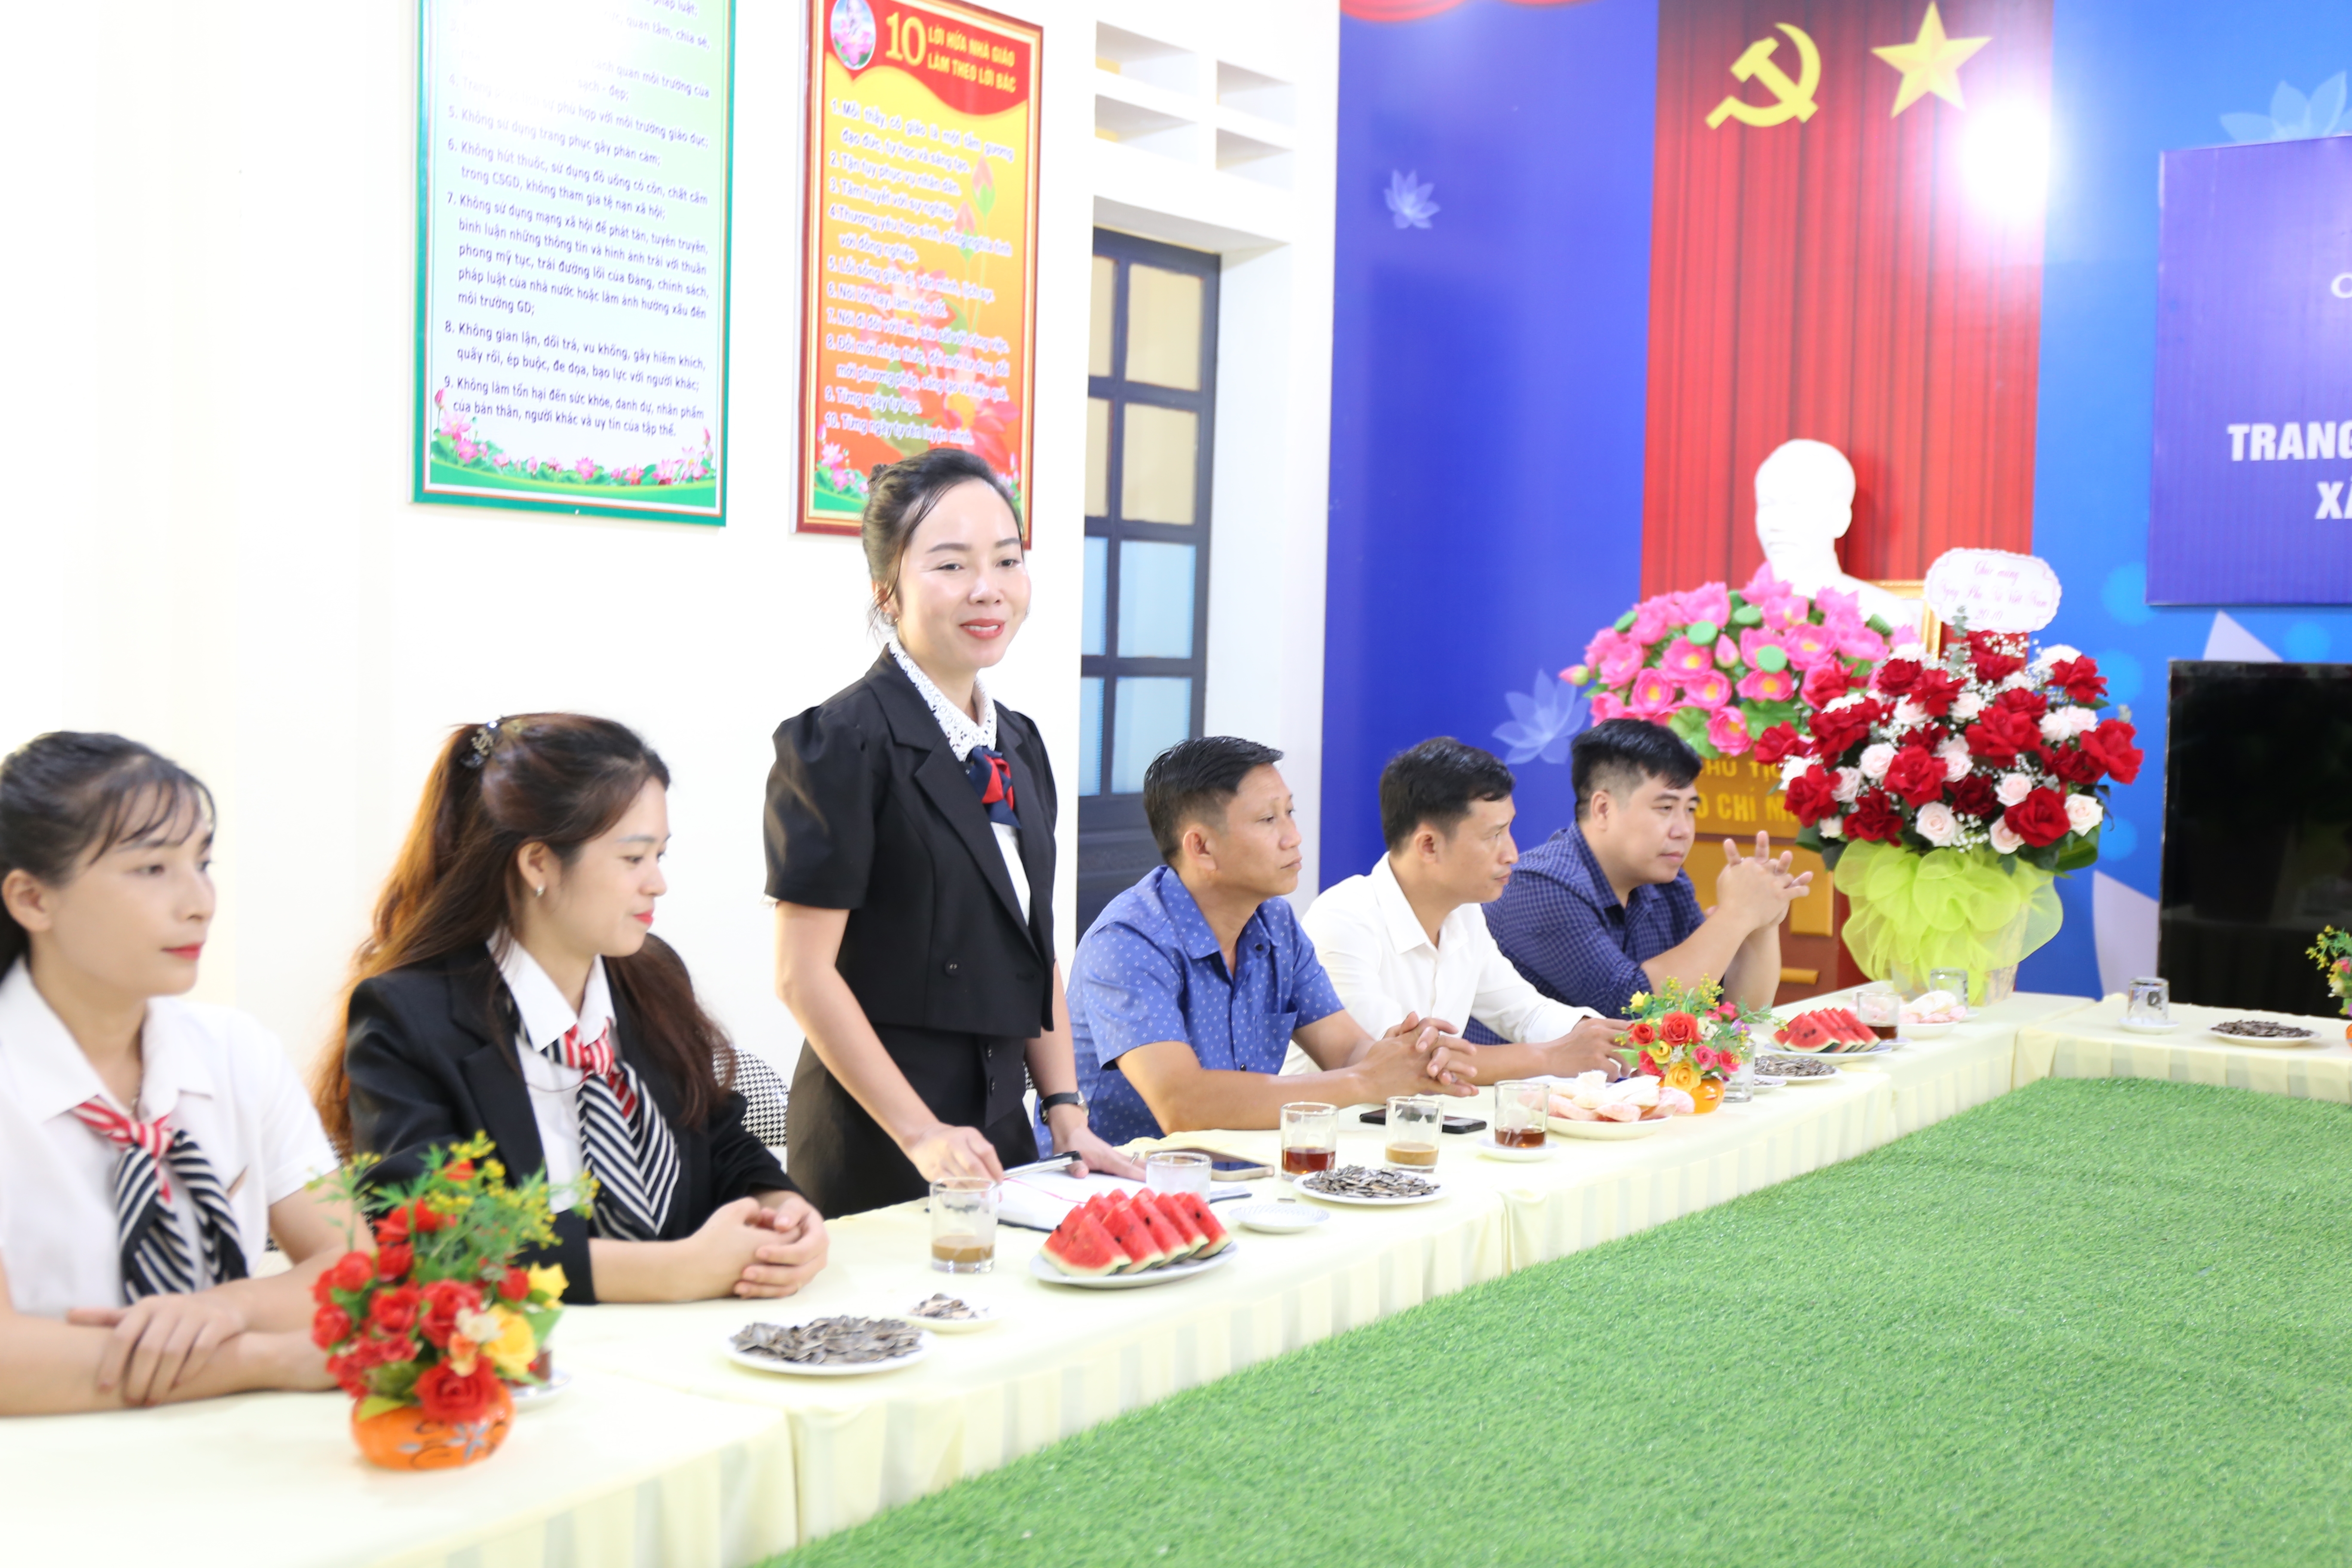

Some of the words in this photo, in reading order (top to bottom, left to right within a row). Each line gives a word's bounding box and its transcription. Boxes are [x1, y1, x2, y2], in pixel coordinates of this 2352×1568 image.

[886, 12, 926, 66] 10
[447, 137, 457, 152] 6.
[461, 140, 494, 162] Không
[497, 147, 514, 164] hút
[517, 153, 548, 173] thuốc,
[565, 163, 590, 183] dụng
[592, 169, 604, 183] đồ
[607, 173, 630, 192] uống
[633, 178, 644, 192] có
[646, 181, 665, 198] cồn,
[668, 187, 687, 201] chất
[689, 190, 707, 205] cấm
[461, 165, 489, 185] trong
[492, 172, 522, 191] CSGD,
[526, 178, 556, 199] không
[559, 186, 583, 201] tham
[586, 193, 600, 206] gia
[603, 194, 612, 210] tệ
[615, 200, 632, 212] nạn
[635, 202, 646, 214] xã
[648, 204, 665, 220] hội;
[830, 177, 839, 192] 3.
[447, 190, 456, 205] 7.
[459, 193, 491, 214] Không
[508, 203, 533, 223] dụng
[536, 211, 562, 228] mạng
[564, 215, 576, 228] xã
[578, 217, 592, 233] hội
[609, 224, 629, 238] phát
[631, 228, 648, 244] tán,
[651, 232, 676, 248] tuyên
[678, 238, 708, 255] truyền,
[459, 217, 481, 233] bình
[484, 222, 506, 239] luận
[509, 228, 541, 248] những
[544, 234, 572, 253] thông
[575, 240, 588, 253] tin
[591, 245, 601, 256] và
[604, 245, 625, 260] hình
[647, 254, 663, 266] trái
[666, 257, 679, 270] với
[681, 260, 707, 275] thuần
[458, 266, 484, 285] pháp
[487, 270, 506, 288] luật
[530, 279, 548, 293] nhà
[551, 283, 574, 297] nước
[577, 286, 599, 303] hoặc
[602, 290, 619, 304] làm
[672, 303, 688, 316] xấu
[690, 306, 706, 319] đến
[459, 242, 492, 262] phong
[496, 250, 512, 266] mỹ
[514, 252, 534, 269] tục,
[537, 256, 555, 270] trái
[558, 260, 589, 279] đường
[593, 266, 605, 279] lối
[657, 279, 683, 293] chính
[686, 283, 709, 300] sách,
[828, 282, 836, 296] 6.
[458, 291, 477, 305] môi
[480, 294, 514, 314] trường
[517, 300, 534, 317] GD;
[444, 319, 454, 333] 8.
[459, 322, 492, 341] Không
[496, 328, 518, 343] gian
[521, 331, 540, 348] lận,
[543, 334, 559, 348] dối
[562, 337, 579, 353] trá,
[582, 343, 594, 353] vu
[597, 342, 630, 361] khống,
[633, 348, 650, 364] gây
[653, 350, 676, 364] hiềm
[678, 354, 706, 372] khích,
[456, 346, 483, 364] quấy
[486, 349, 503, 366] rối,
[506, 352, 519, 368] ép
[522, 355, 549, 372] buộc,
[553, 359, 565, 372] đe
[568, 361, 589, 377] dọa,
[592, 364, 610, 380] bạo
[612, 367, 627, 382] lực
[629, 370, 643, 383] với
[646, 375, 672, 388] người
[675, 376, 699, 393] khác;
[444, 375, 453, 388] 9.
[457, 377, 488, 395] Không
[492, 380, 509, 395] làm
[531, 386, 546, 401] hại
[549, 388, 566, 402] đến
[569, 391, 585, 404] sức
[615, 397, 637, 410] danh
[640, 400, 654, 415] dự,
[656, 402, 678, 416] nhân
[825, 386, 834, 402] 9.
[496, 404, 521, 421] thân,
[524, 410, 552, 423] người
[555, 411, 578, 425] khác
[580, 416, 591, 427] và
[594, 418, 606, 431] uy
[608, 416, 621, 430] tín
[642, 421, 657, 436] tập
[1717, 786, 1756, 822] CHÍ
